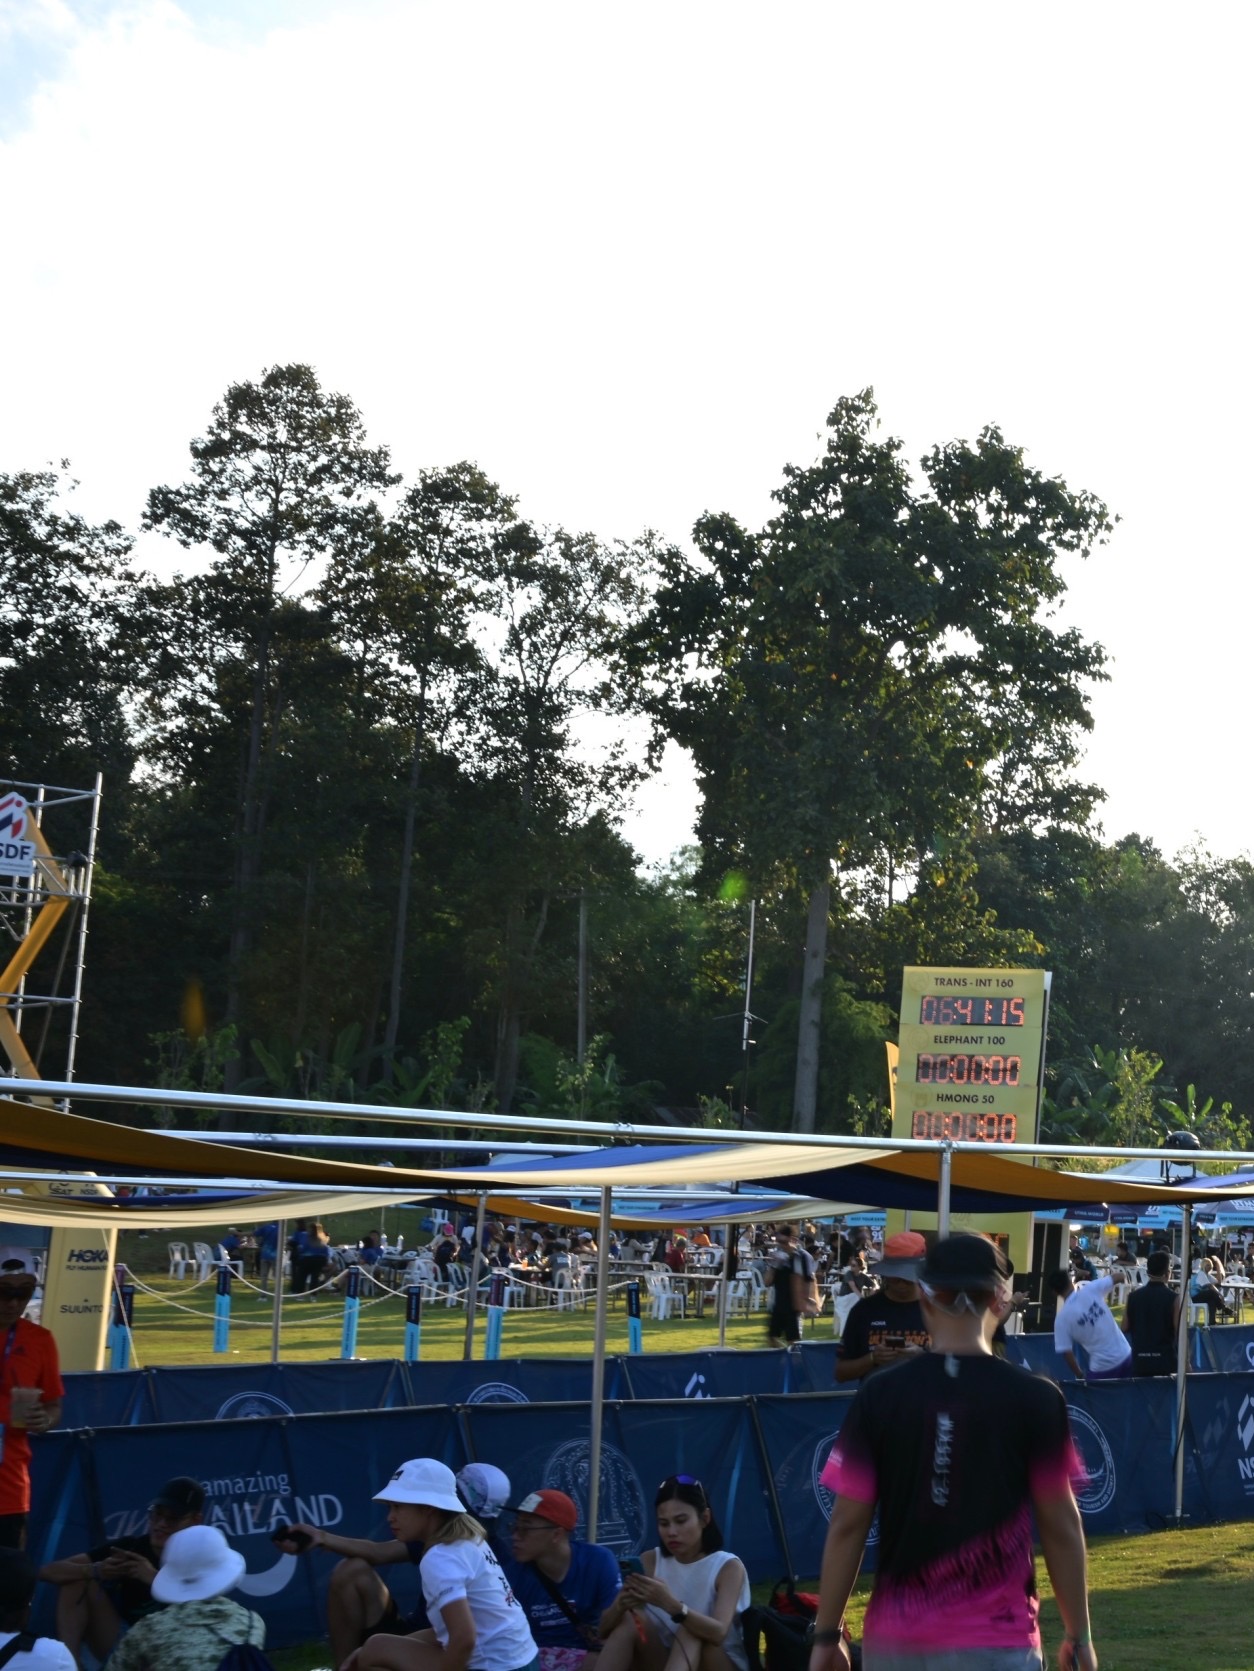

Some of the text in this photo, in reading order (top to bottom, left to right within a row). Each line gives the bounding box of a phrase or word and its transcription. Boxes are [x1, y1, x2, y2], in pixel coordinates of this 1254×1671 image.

[0, 842, 31, 860] DF
[934, 977, 968, 987] TRANS
[975, 978, 992, 988] INT
[996, 978, 1014, 988] 160
[933, 1035, 1006, 1046] ELEPHANT 100
[918, 1054, 1022, 1086] 00:00:00
[936, 1093, 995, 1104] HMONG 50
[201, 1470, 292, 1495] amazing
[209, 1493, 344, 1537] AILAND
